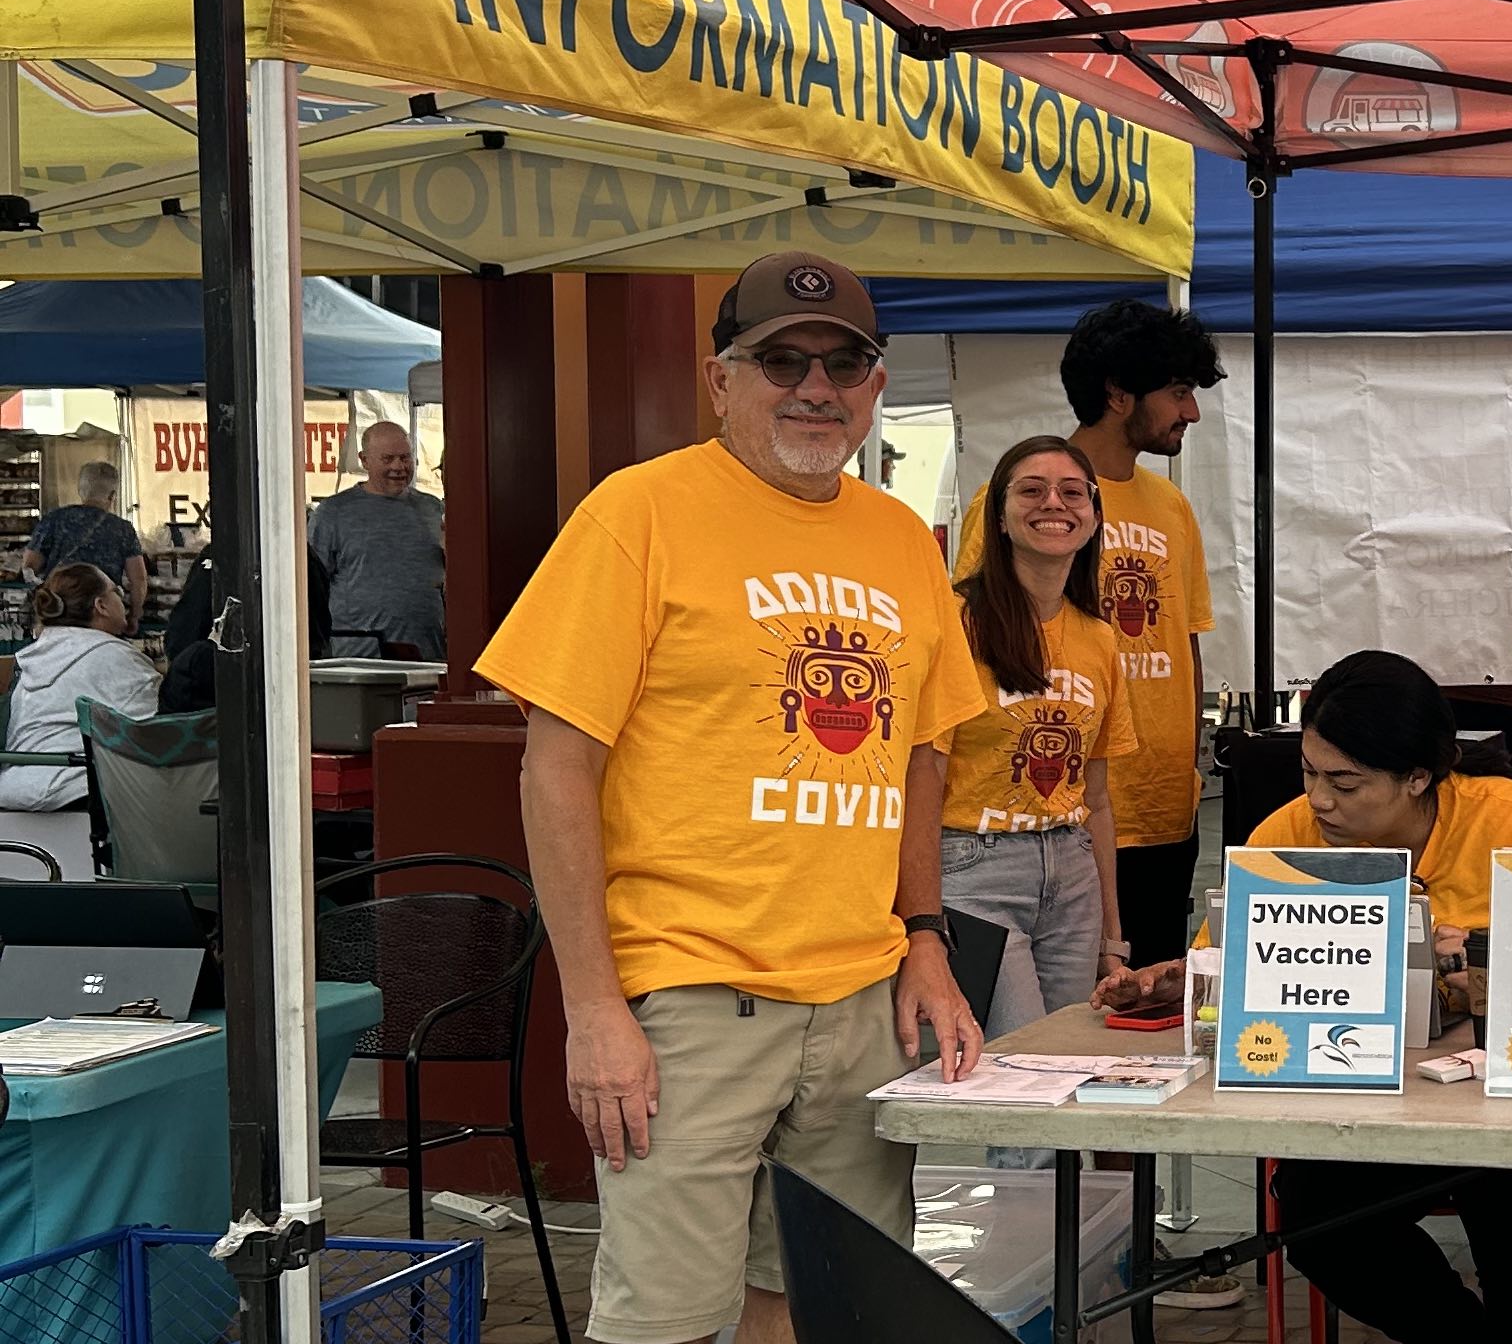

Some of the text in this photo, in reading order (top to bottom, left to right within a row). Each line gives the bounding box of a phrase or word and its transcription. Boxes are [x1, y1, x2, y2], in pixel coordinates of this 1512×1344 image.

[1001, 74, 1151, 225] BOOTH
[1104, 521, 1168, 558] DIOS
[744, 571, 902, 633] ADIOS
[751, 777, 903, 829] COVID
[1252, 903, 1384, 926] JYNNOES
[1255, 941, 1371, 965] Vaccine
[1280, 983, 1350, 1007] Here
[1254, 1035, 1272, 1046] No
[1247, 1052, 1278, 1063] Cost!
